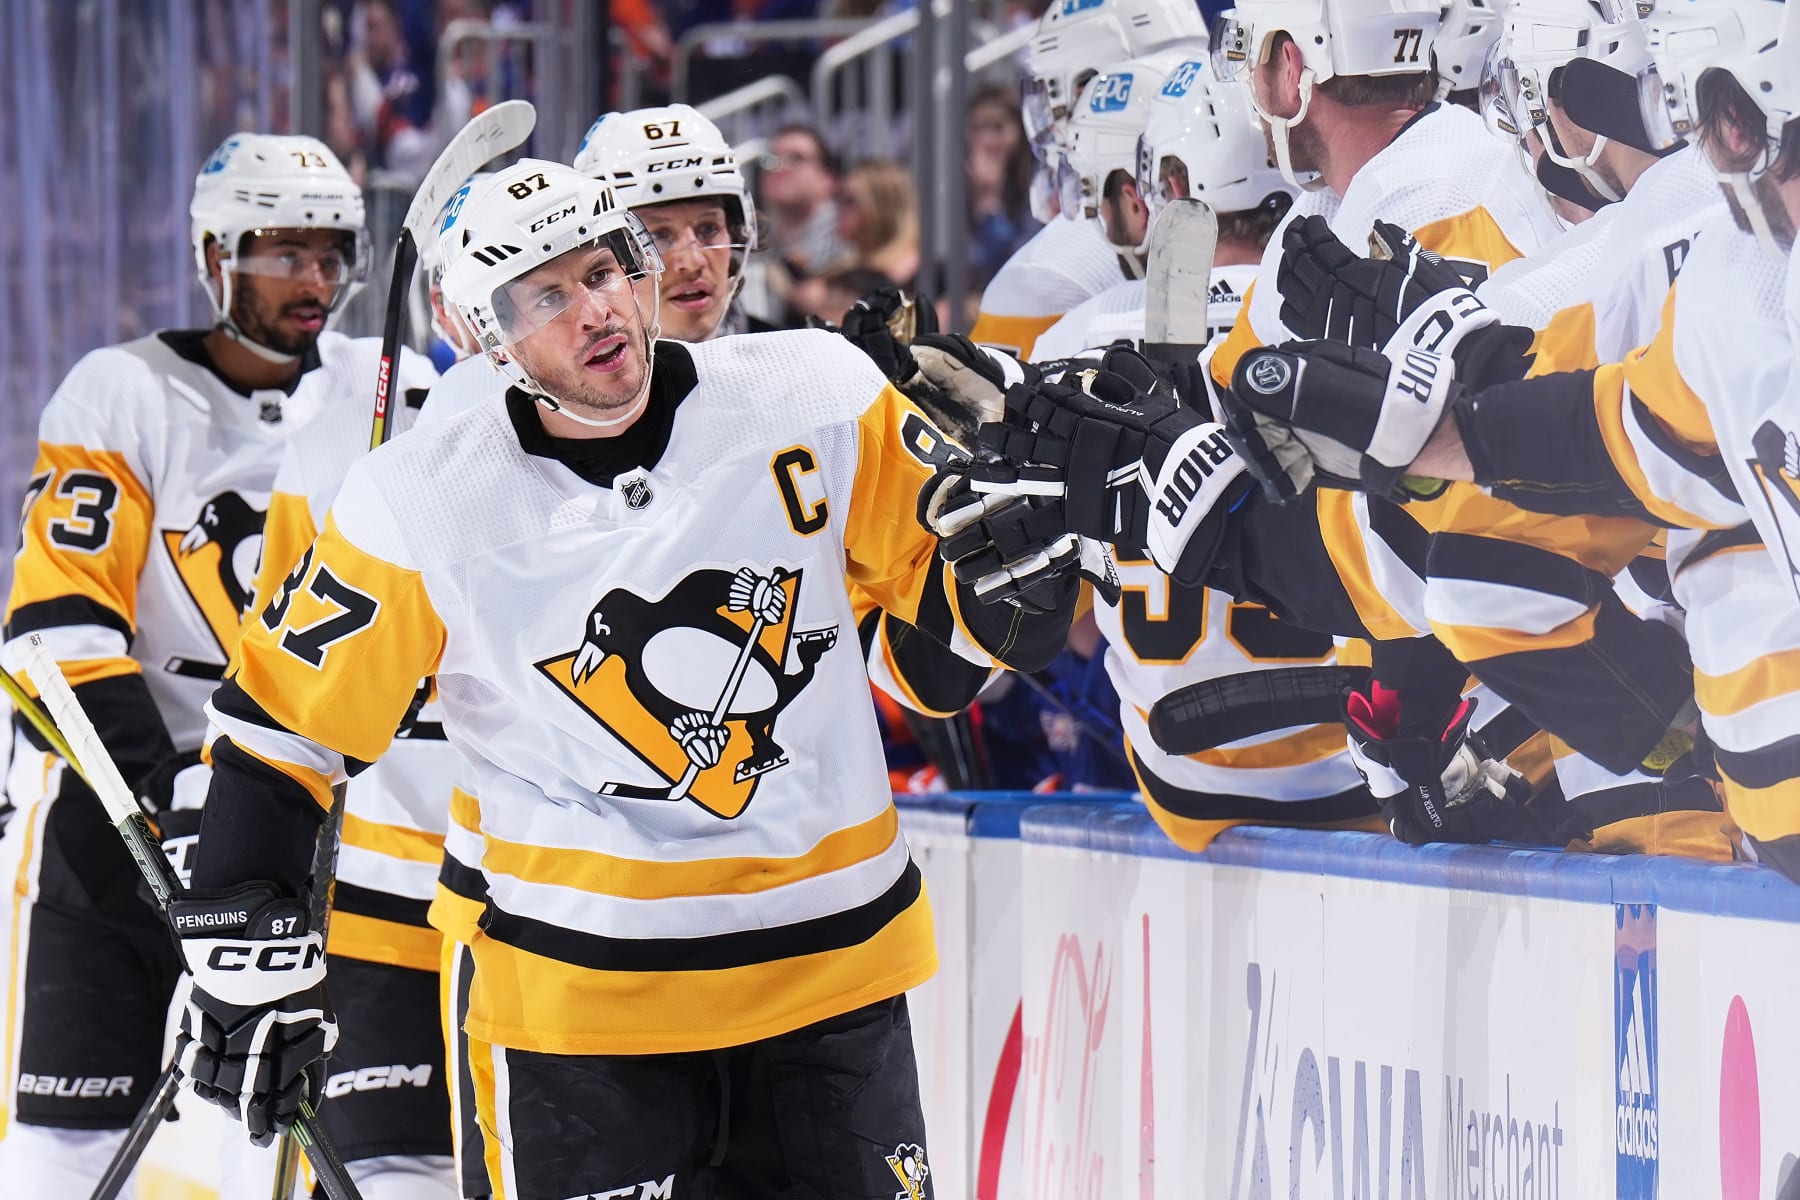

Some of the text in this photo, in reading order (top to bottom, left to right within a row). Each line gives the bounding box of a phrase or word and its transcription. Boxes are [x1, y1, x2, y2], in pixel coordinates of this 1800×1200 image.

[1393, 28, 1423, 62] 77
[643, 119, 682, 141] 67
[647, 156, 703, 173] CCM
[507, 173, 551, 200] 87
[530, 205, 577, 234] CCM
[1207, 294, 1242, 304] didas
[376, 359, 391, 414] CCM
[770, 444, 828, 538] C
[1156, 429, 1233, 527] RIOR
[631, 485, 645, 506] NHL
[30, 633, 42, 646] 87
[1423, 800, 1442, 828] CARTER
[176, 911, 247, 928] PENGUINS
[272, 917, 297, 934] 87
[207, 942, 326, 971] CCM
[325, 1064, 433, 1098] CCM
[1445, 1073, 1562, 1200] Merchant
[1616, 1091, 1658, 1160] adidas
